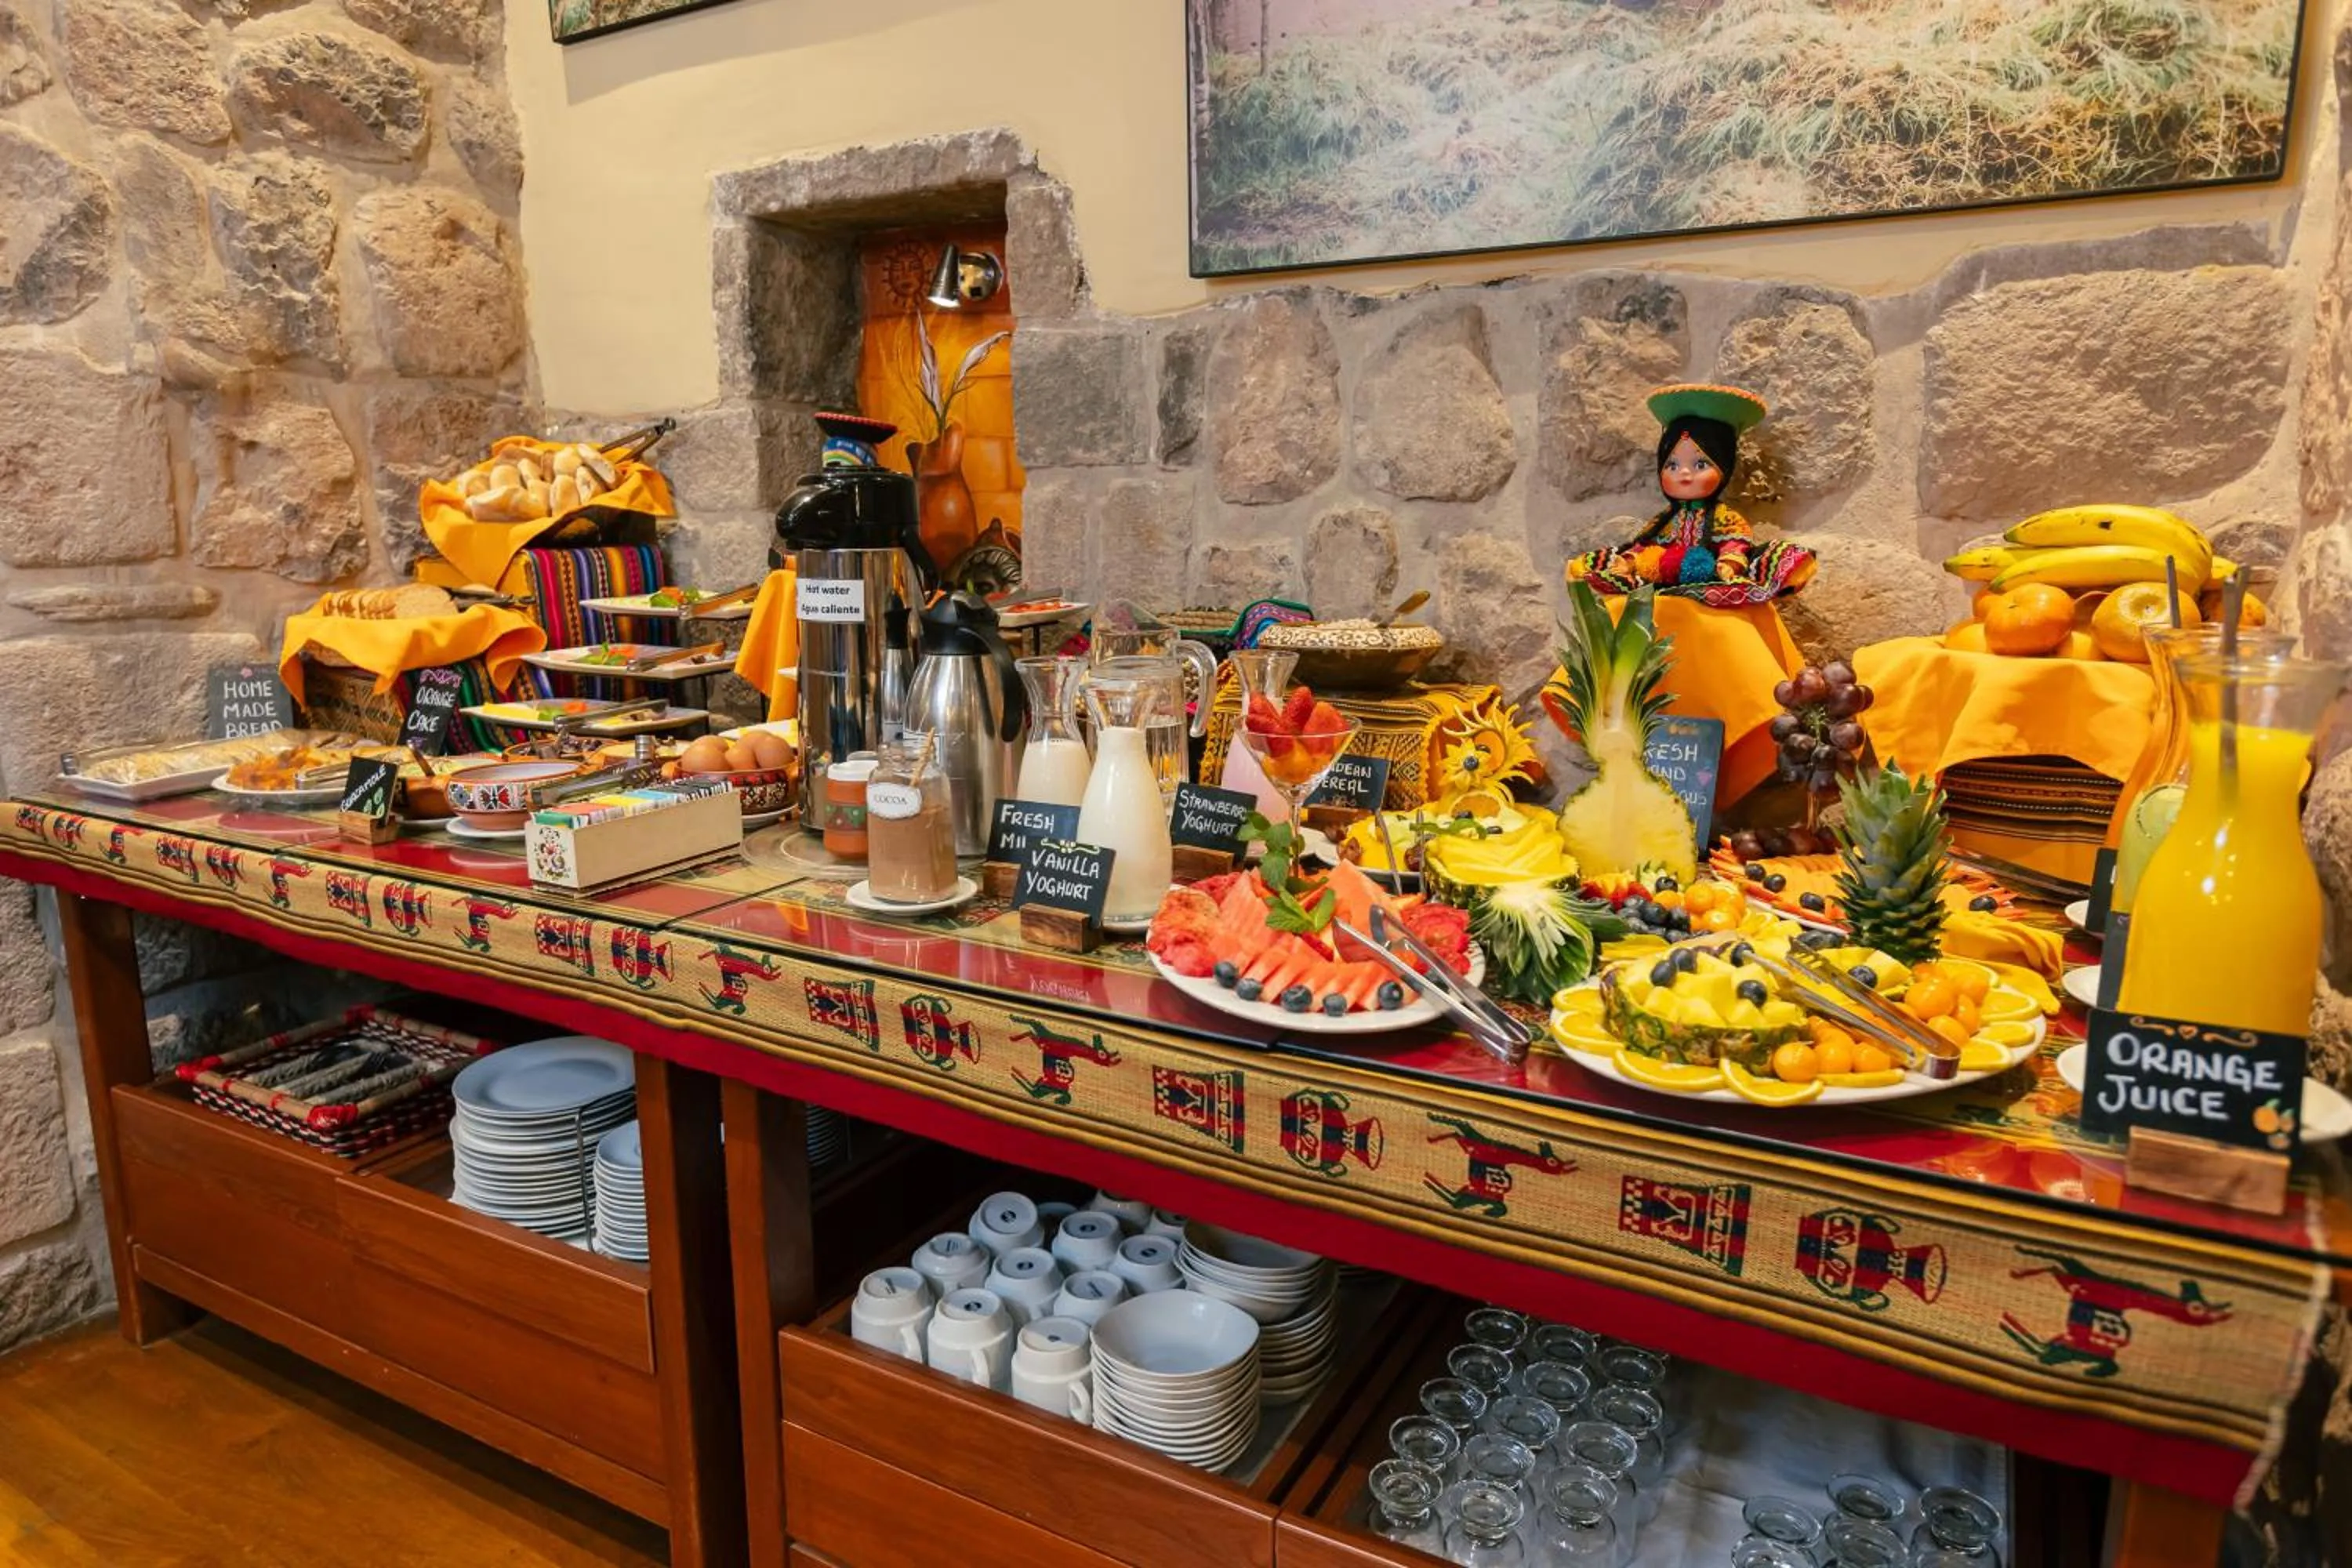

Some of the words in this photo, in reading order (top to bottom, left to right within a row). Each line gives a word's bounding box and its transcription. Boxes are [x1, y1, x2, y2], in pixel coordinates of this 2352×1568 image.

[805, 585, 819, 594] Hot
[822, 586, 851, 595] water
[801, 603, 819, 615] Agua
[821, 603, 860, 614] caliente
[223, 680, 274, 699] HOME
[416, 686, 456, 708] ORANGE
[223, 701, 277, 718] MADE
[407, 710, 440, 732] CAKE
[1643, 742, 1698, 762] RESH
[1319, 776, 1370, 797] EREAL
[1179, 789, 1247, 822] STRAWBERR
[1000, 804, 1054, 834] FRESH
[1181, 810, 1237, 836] YOGHURT
[1032, 849, 1100, 879] VANILLA
[1025, 870, 1092, 901] YOGHURT
[2107, 1032, 2283, 1093] ORANGE
[2097, 1074, 2230, 1121] JUICE
